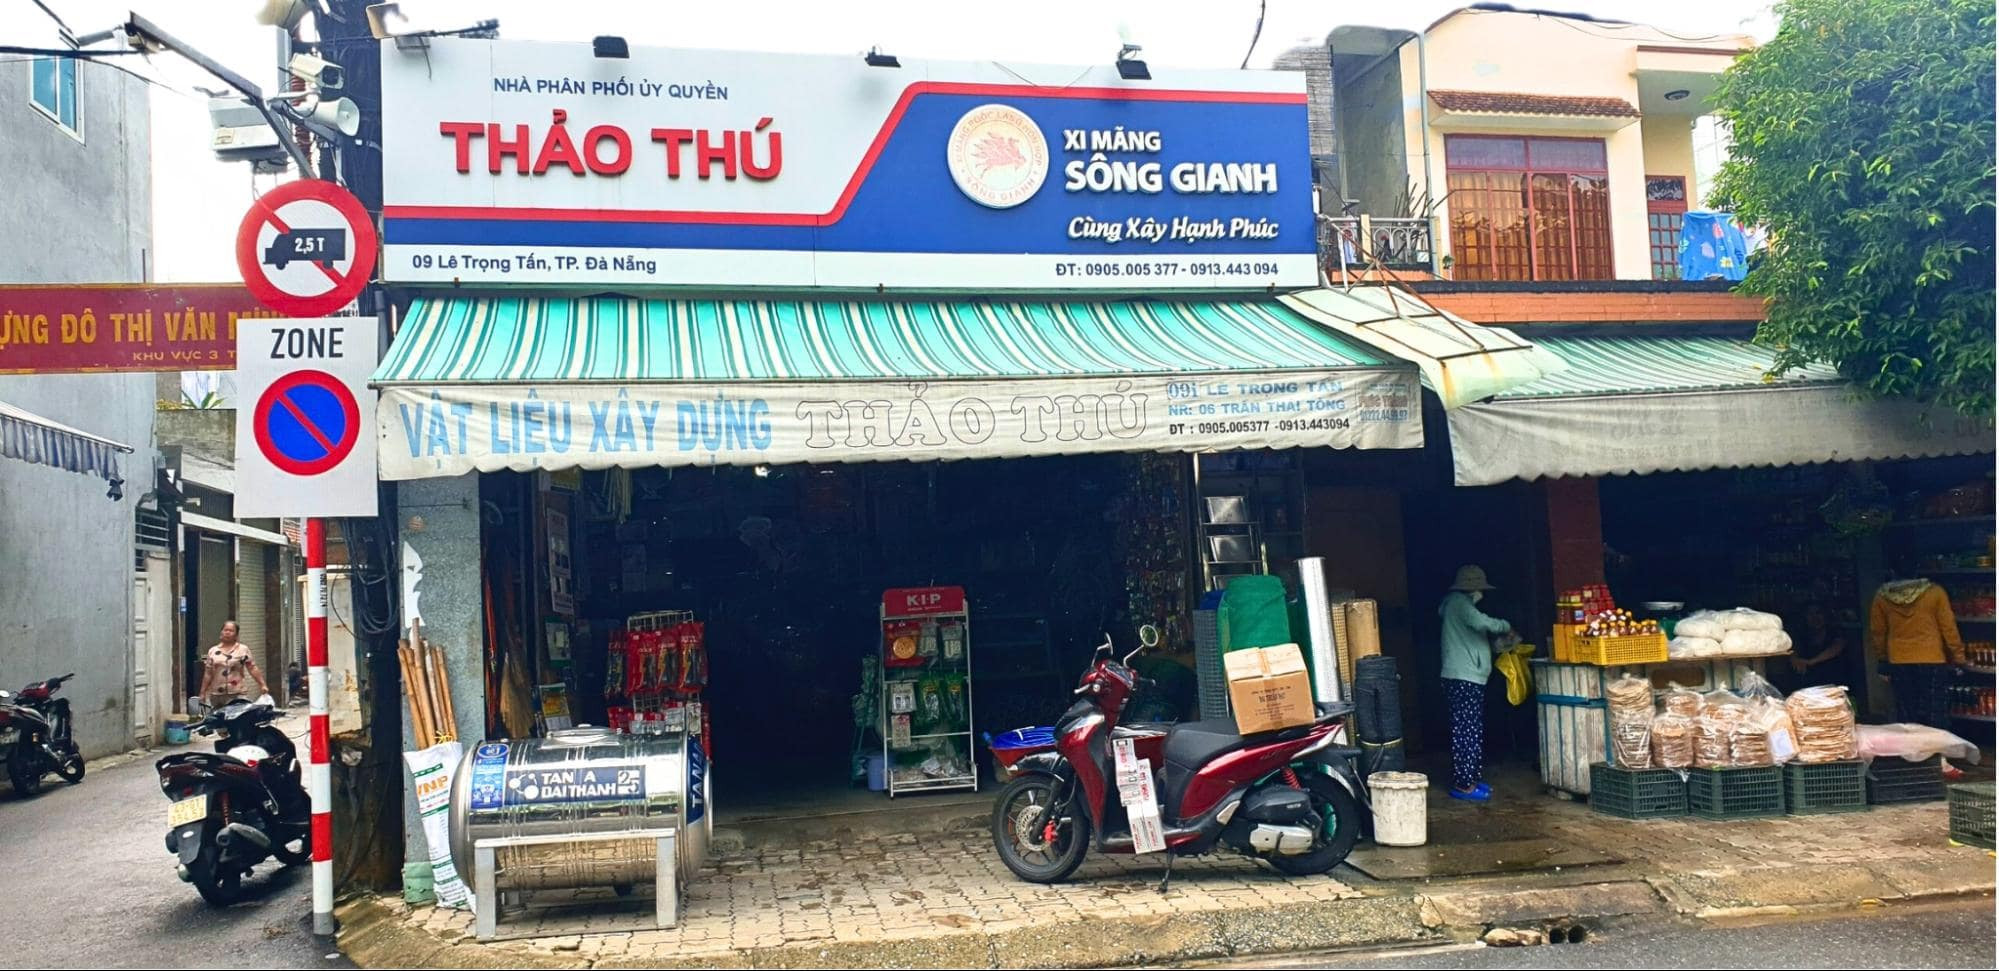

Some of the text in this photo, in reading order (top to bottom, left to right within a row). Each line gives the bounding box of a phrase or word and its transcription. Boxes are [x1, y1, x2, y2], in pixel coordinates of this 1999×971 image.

[494, 75, 729, 100] NHÀ PHÂN PHỐI ỦY QUYỀN
[440, 109, 783, 180] THẢO THÚ
[1063, 128, 1087, 151] XI
[1091, 126, 1162, 152] MĂNG
[1065, 152, 1163, 192] SÔNG
[1170, 162, 1278, 193] GIANH
[1068, 216, 1279, 243] Cùng Xây Hạnh Phúc
[295, 237, 325, 255] 2,5 T
[412, 253, 657, 274] 09 Lê Trọng Tấn, TP. Đà Nẵng
[1056, 262, 1081, 276] ĐT:
[1085, 263, 1150, 277] 0905.005
[1190, 263, 1250, 277] 0913.443
[61, 308, 97, 344] ĐÔ
[109, 308, 153, 347] THỊ
[164, 306, 216, 341] VĂN
[133, 351, 164, 361] KHU
[209, 350, 219, 360] 3
[270, 328, 344, 359] ZONE
[587, 386, 661, 452] XÂY
[796, 380, 1149, 448] THẢO THÚ
[1169, 424, 1185, 435] ĐT
[1199, 421, 1270, 434] 0905.005377
